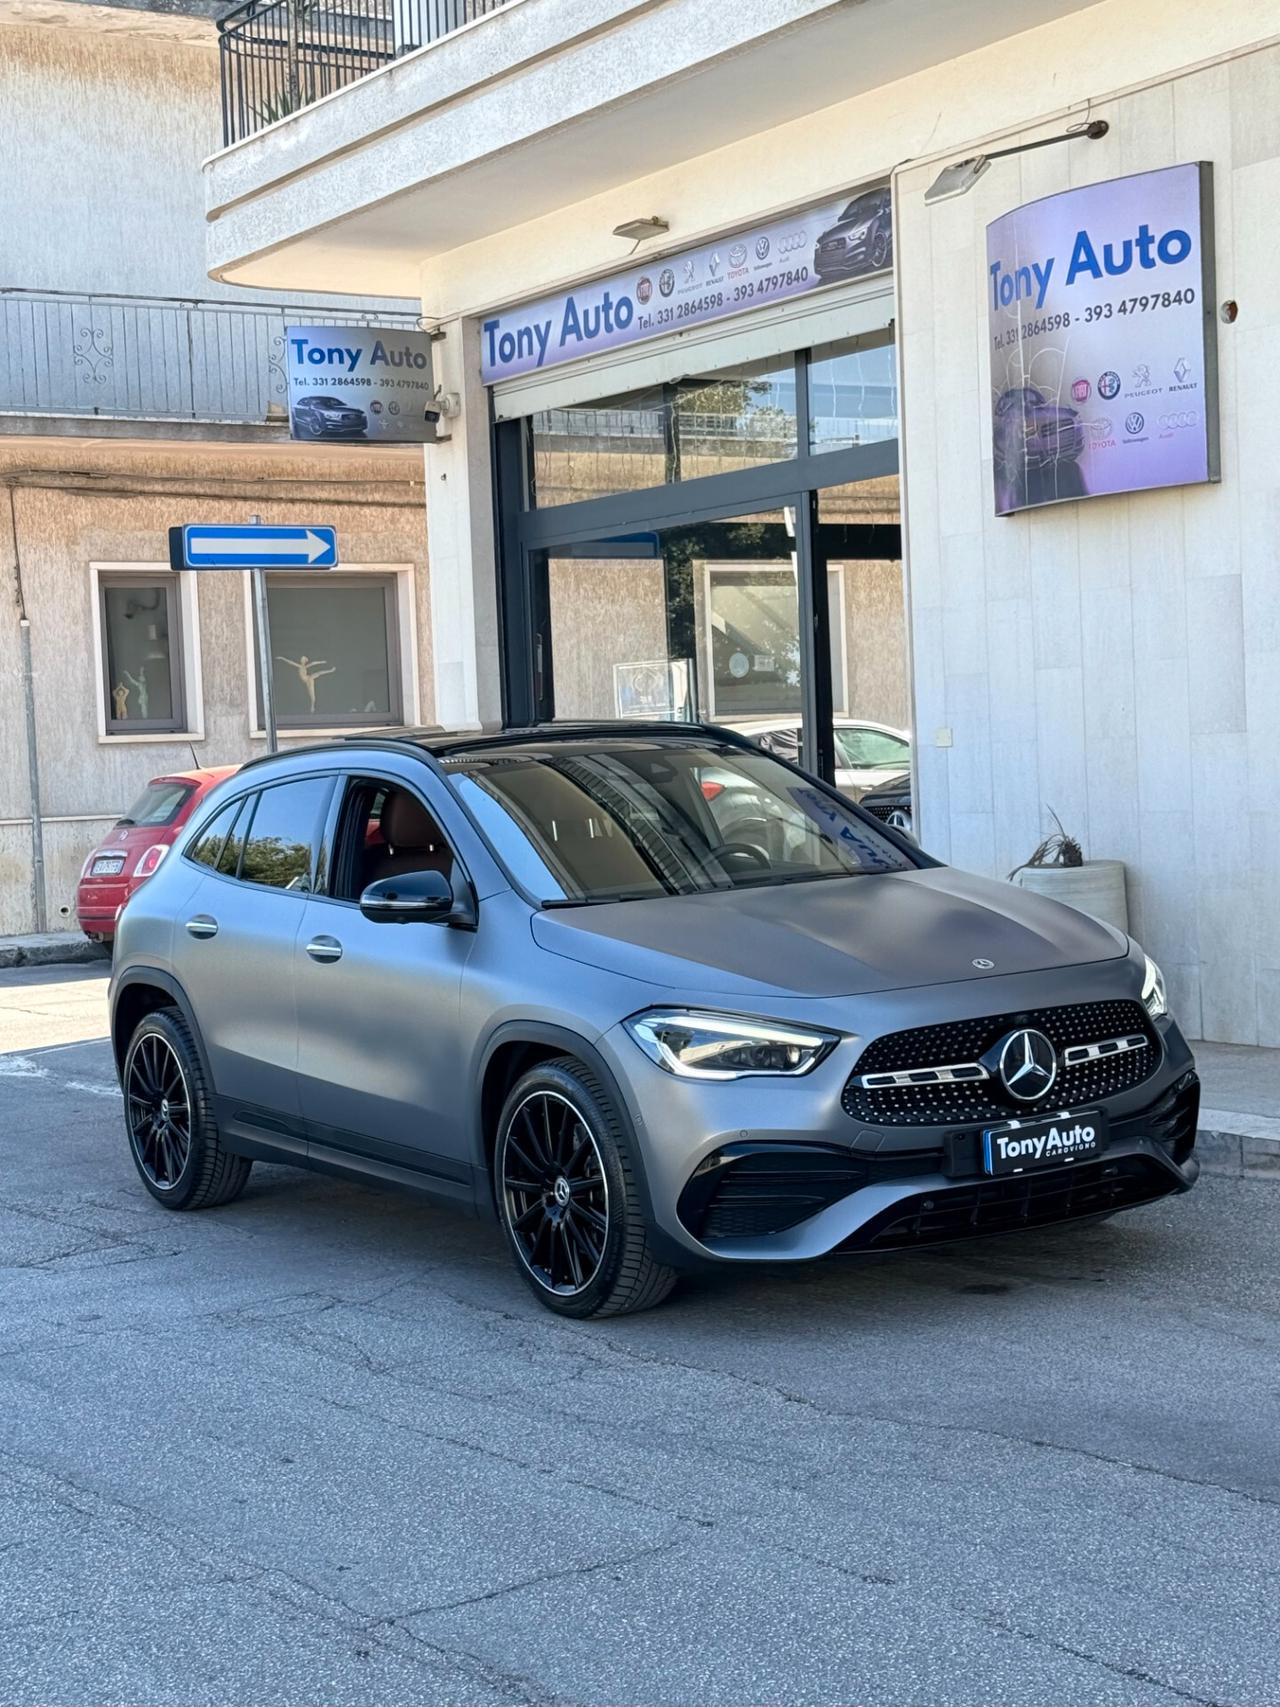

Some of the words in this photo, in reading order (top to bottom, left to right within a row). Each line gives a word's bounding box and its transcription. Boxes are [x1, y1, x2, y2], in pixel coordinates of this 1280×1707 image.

[727, 267, 749, 280] TOYOTA
[990, 257, 1055, 312] Tony
[1065, 224, 1192, 286] Auto
[638, 313, 654, 330] Tel.
[657, 307, 673, 324] 331
[677, 292, 723, 319] 2864598
[734, 282, 754, 302] 393
[757, 266, 808, 294] 4797840
[483, 319, 552, 368] Tony
[559, 291, 633, 347] Auto
[1006, 328, 1019, 345] 331
[1021, 312, 1070, 340] 2864598
[1084, 303, 1113, 323] 393
[1117, 288, 1195, 316] 4797840
[291, 339, 362, 372] Tony
[370, 340, 427, 370] Auto
[294, 377, 310, 386] Tel.
[312, 377, 328, 386] 331
[331, 377, 371, 387] 2864598
[380, 378, 395, 388] 393
[396, 379, 429, 391] 4797840
[1124, 387, 1163, 399] PEUGEOT
[1168, 383, 1198, 392] RENAULT
[1045, 1141, 1096, 1157] CAROVIGNO
